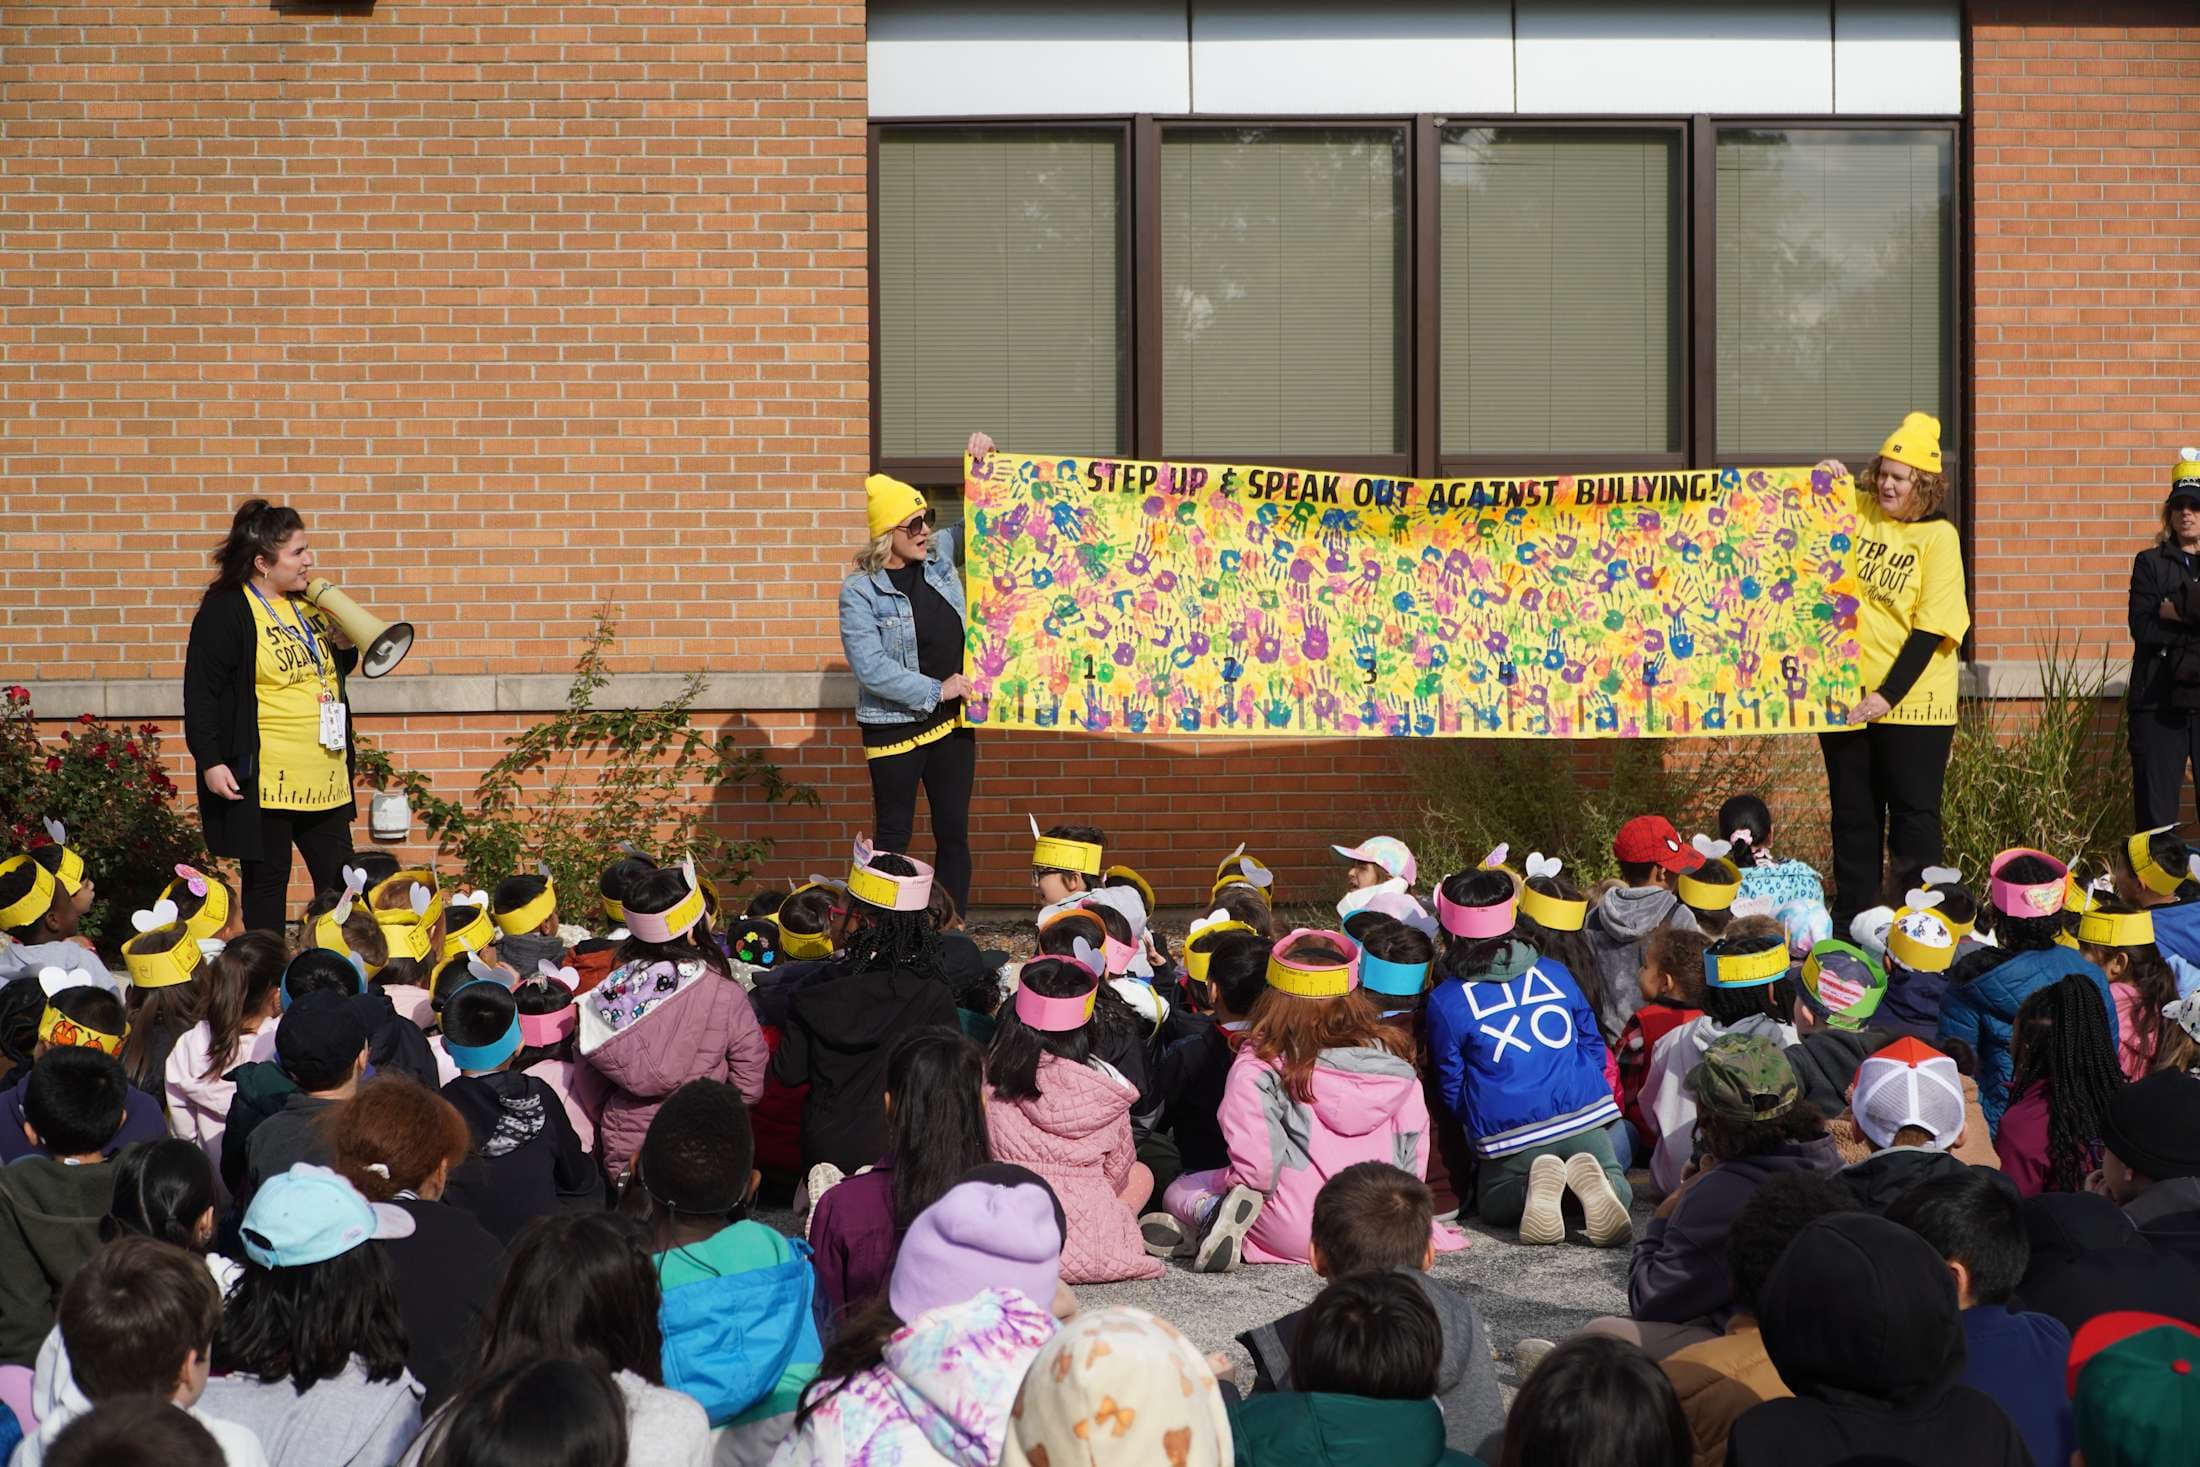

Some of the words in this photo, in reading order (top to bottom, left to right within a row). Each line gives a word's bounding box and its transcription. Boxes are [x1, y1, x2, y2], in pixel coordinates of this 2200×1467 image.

[1087, 461, 1158, 495] STEP
[1169, 467, 1208, 496] UP
[1248, 469, 1341, 504] SPEAK
[1353, 478, 1414, 508] OUT
[1426, 481, 1560, 509] AGAINST
[1575, 473, 1719, 505] BULLYING!
[1856, 535, 1888, 561] TEP
[1880, 567, 1911, 594] OUT
[1083, 654, 1096, 680] 1
[1223, 656, 1237, 682] 2
[1363, 659, 1377, 684] 3
[1782, 655, 1797, 681] 6
